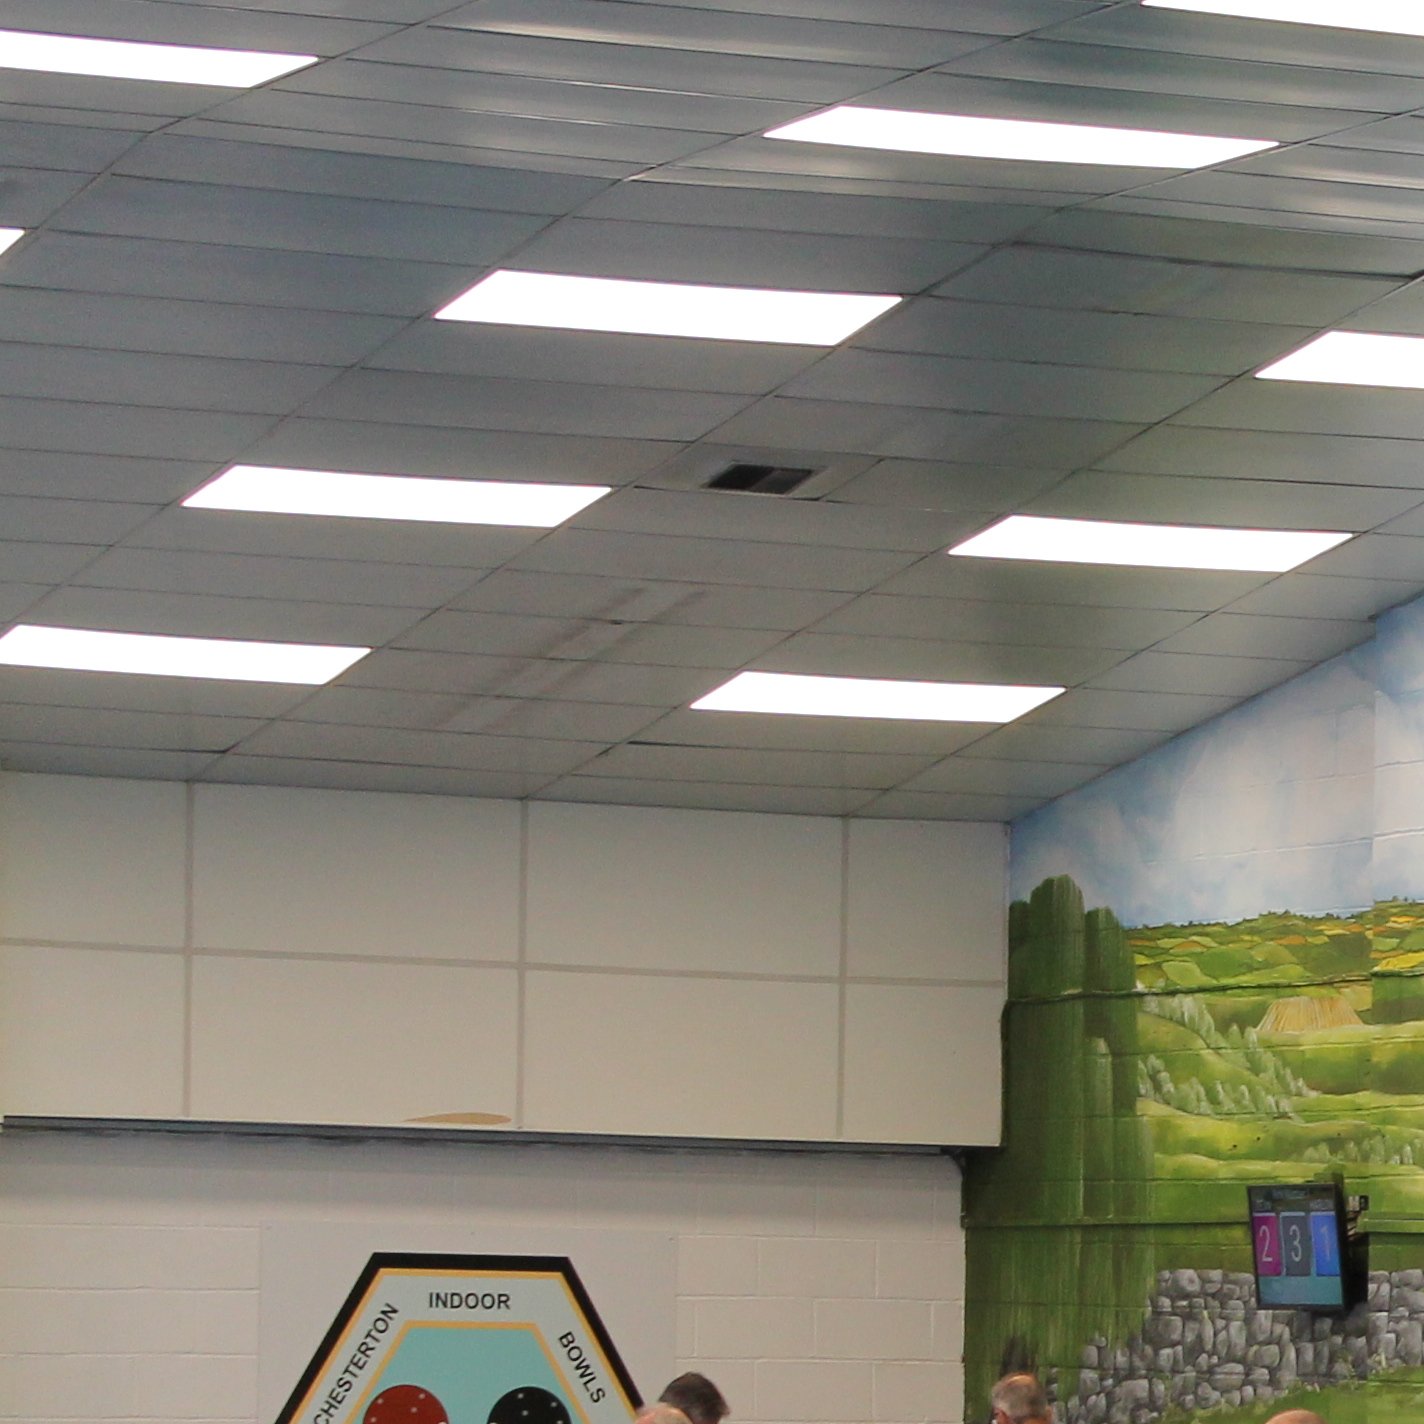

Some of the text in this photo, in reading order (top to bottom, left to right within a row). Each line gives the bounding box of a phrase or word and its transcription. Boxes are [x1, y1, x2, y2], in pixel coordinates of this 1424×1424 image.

[1259, 1225, 1273, 1262] 2
[1289, 1224, 1302, 1262] 3
[428, 1292, 511, 1311] INDOOR
[558, 1331, 606, 1404] BOWLS
